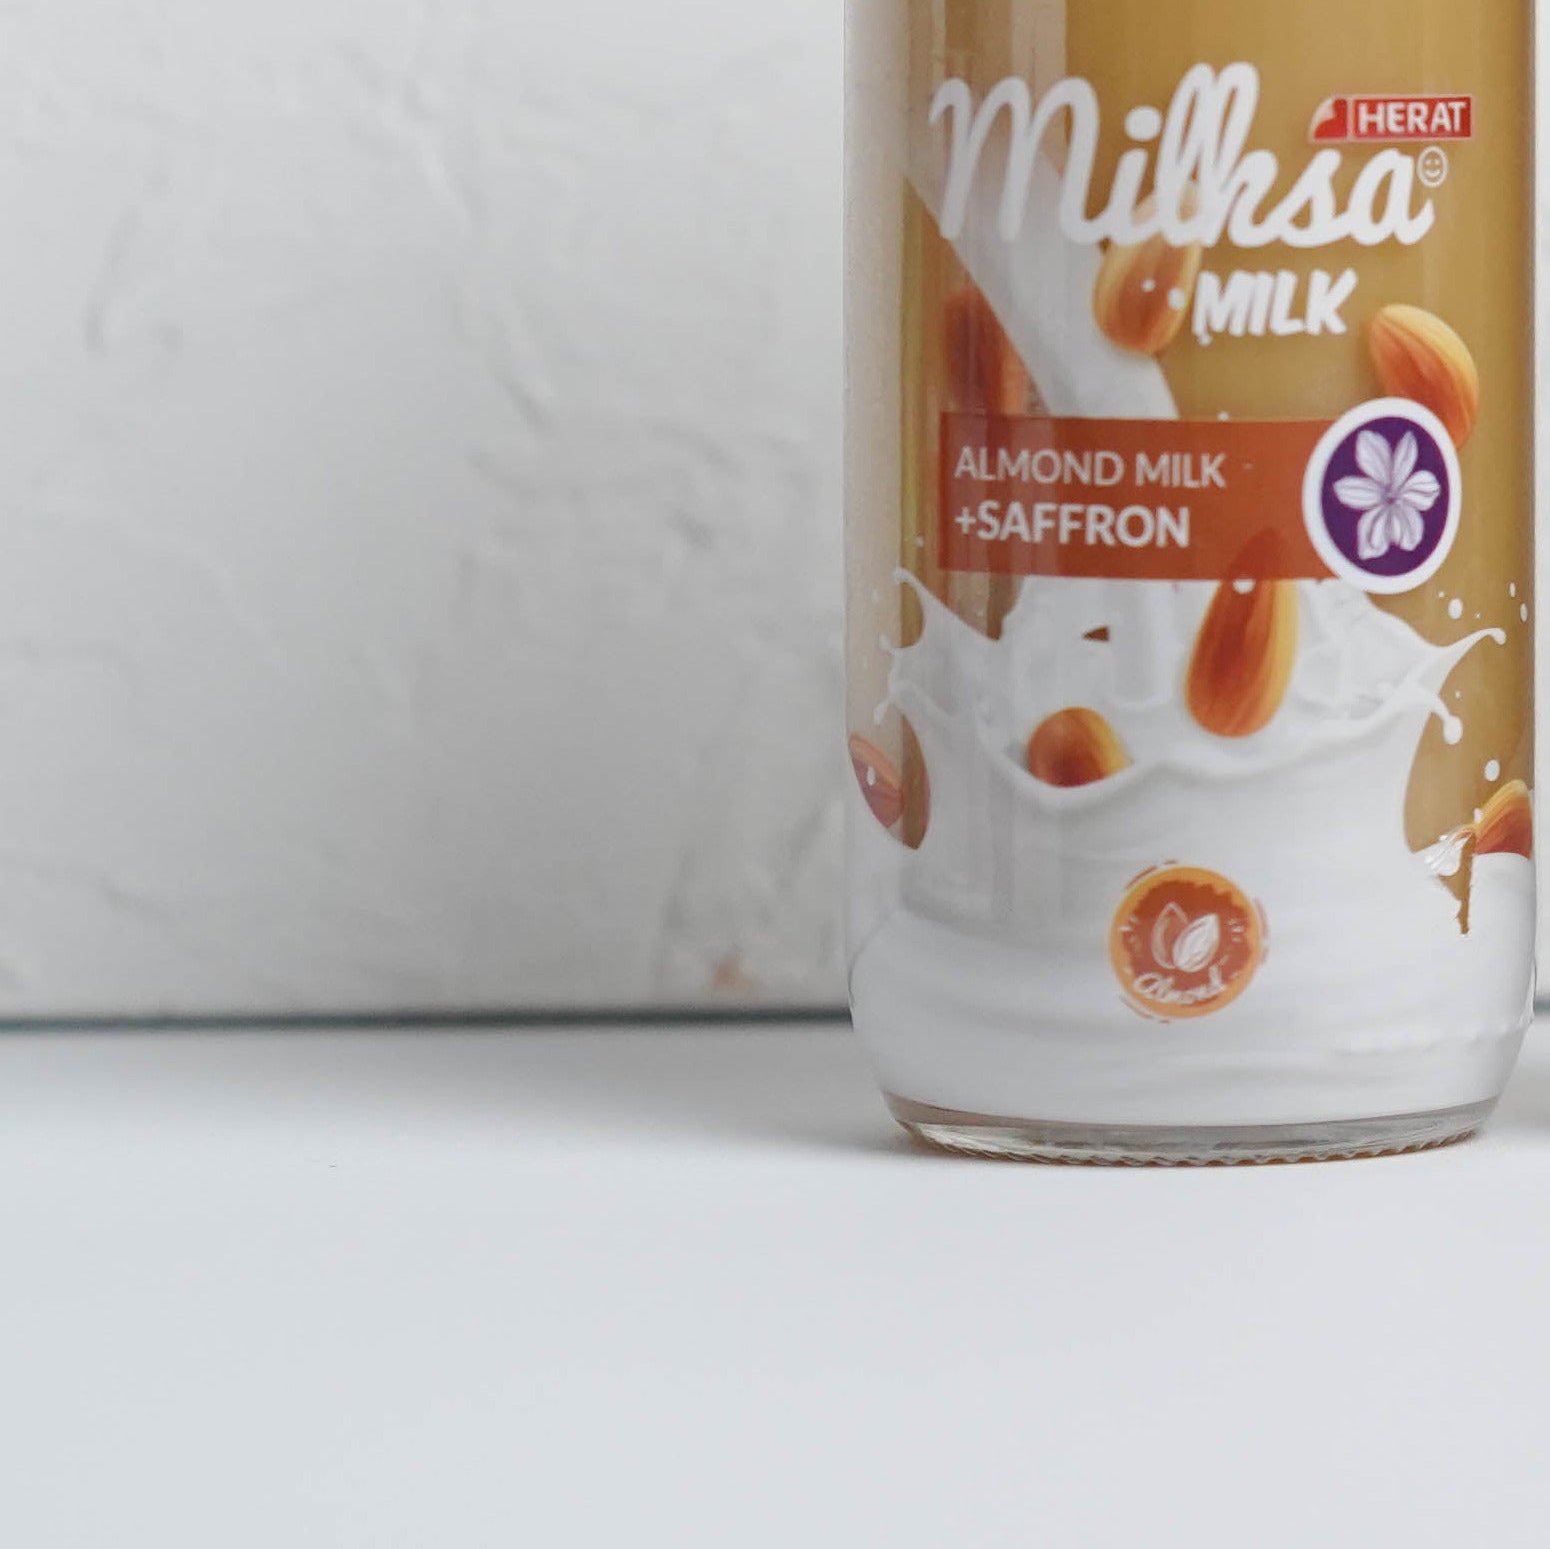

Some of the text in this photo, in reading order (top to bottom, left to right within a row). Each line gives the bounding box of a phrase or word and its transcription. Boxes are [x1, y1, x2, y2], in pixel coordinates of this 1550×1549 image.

[1357, 100, 1468, 136] HERAT
[928, 61, 1436, 249] Milksa
[1192, 267, 1358, 346] MILK
[954, 445, 1227, 489] ALMOND MILK
[954, 499, 1190, 548] +SAFFRON
